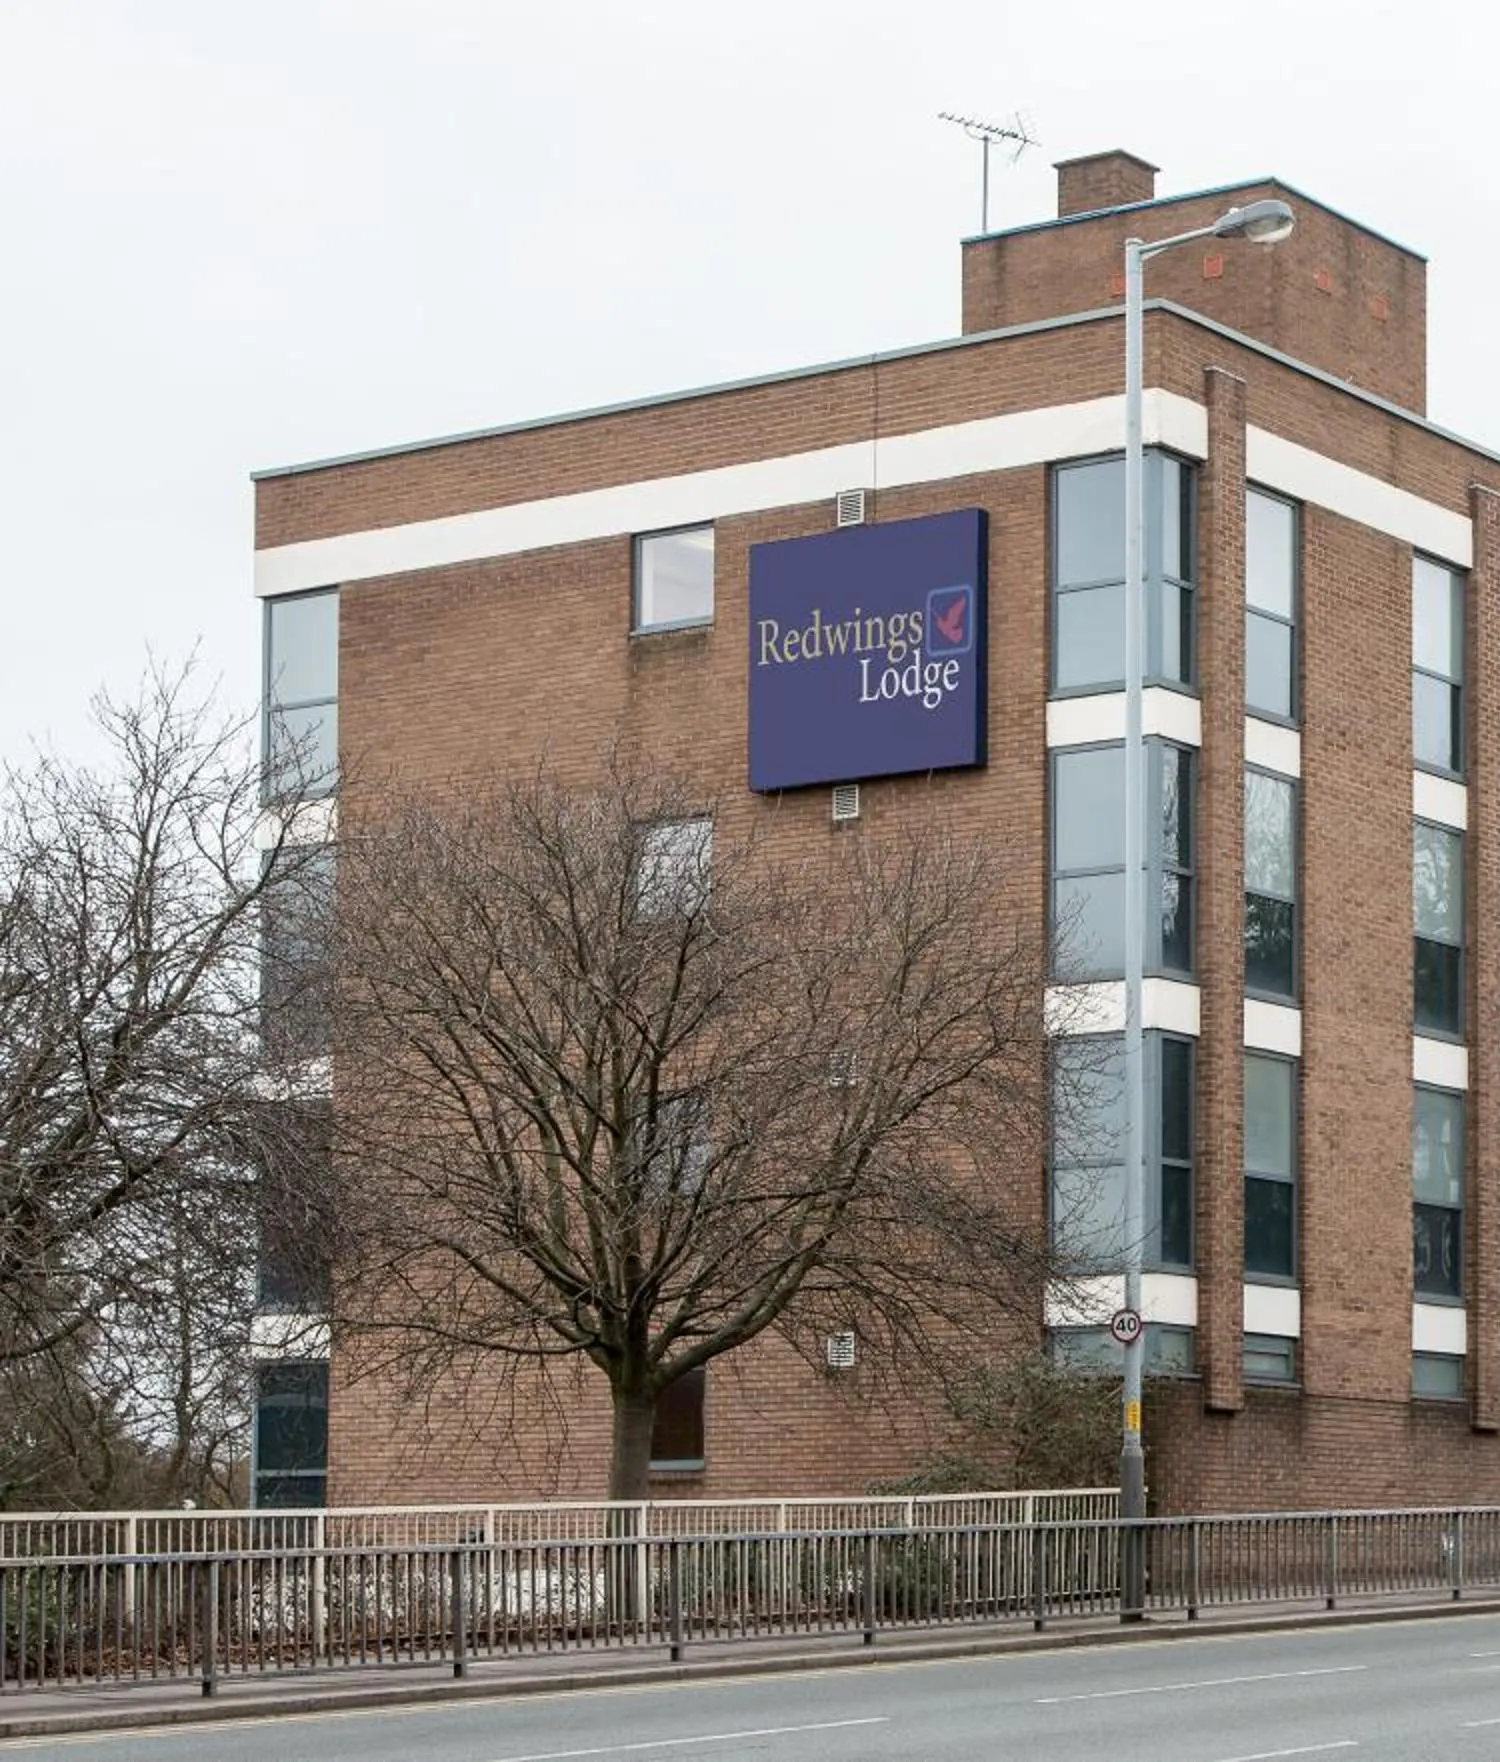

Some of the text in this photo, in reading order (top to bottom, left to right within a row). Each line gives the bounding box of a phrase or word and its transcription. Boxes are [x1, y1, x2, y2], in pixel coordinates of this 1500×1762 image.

[757, 607, 924, 664] Redwings
[859, 647, 960, 709] Lodge
[1116, 1317, 1136, 1332] 40
